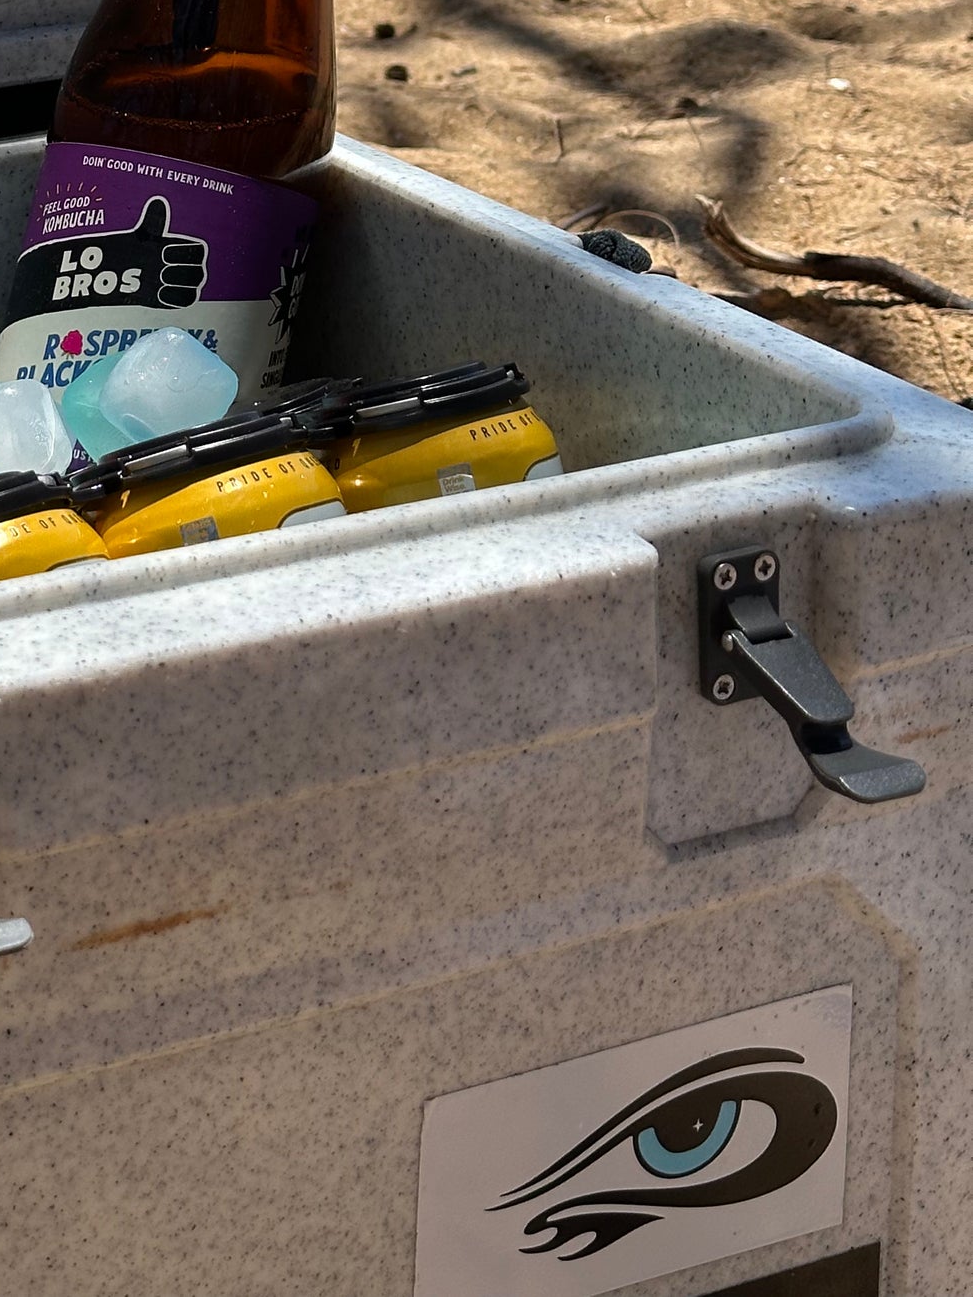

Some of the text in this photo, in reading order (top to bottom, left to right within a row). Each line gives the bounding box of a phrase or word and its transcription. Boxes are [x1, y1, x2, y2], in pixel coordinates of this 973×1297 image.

[107, 159, 134, 172] GOOD
[137, 163, 164, 178] WITH
[167, 169, 200, 187] EVERY
[202, 177, 234, 195] DRINK
[43, 196, 91, 216] FEEL GOOD
[42, 209, 105, 235] KOMBUCHA
[59, 246, 103, 273] LO
[52, 268, 142, 301] BROS
[469, 419, 516, 441] PRIDE
[518, 413, 533, 426] OF
[216, 467, 273, 493] PRIDE
[278, 460, 296, 474] OF
[38, 517, 57, 529] OF
